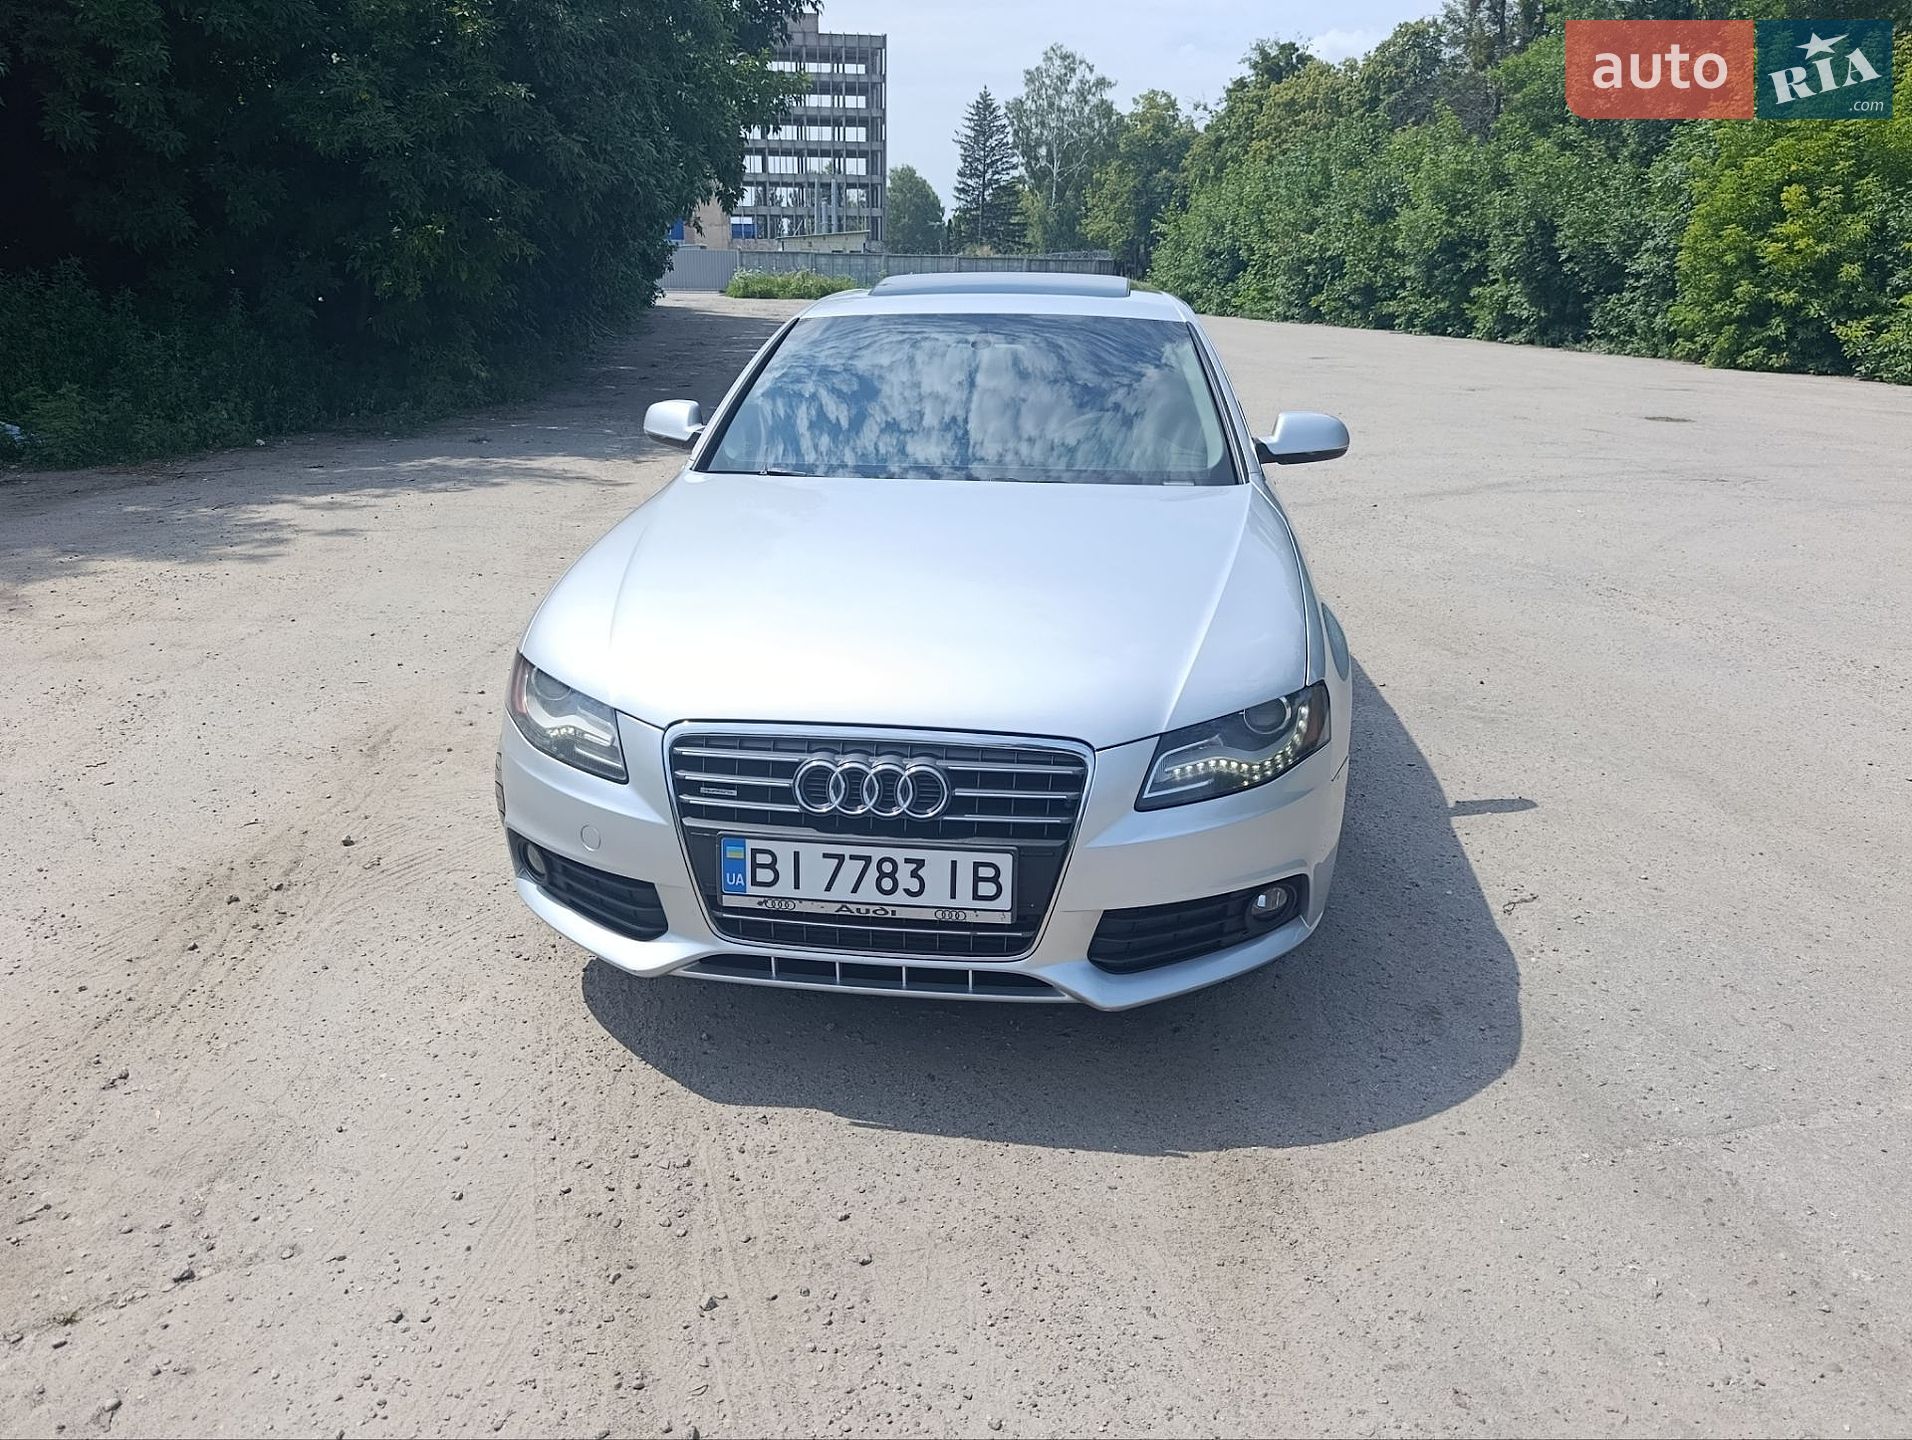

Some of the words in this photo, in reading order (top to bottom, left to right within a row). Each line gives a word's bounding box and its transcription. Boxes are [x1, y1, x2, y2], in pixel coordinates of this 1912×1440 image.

[726, 872, 745, 887] UA
[750, 848, 801, 890] BI
[822, 853, 926, 898] 7783
[950, 860, 1003, 901] IB
[834, 904, 897, 917] Audi
